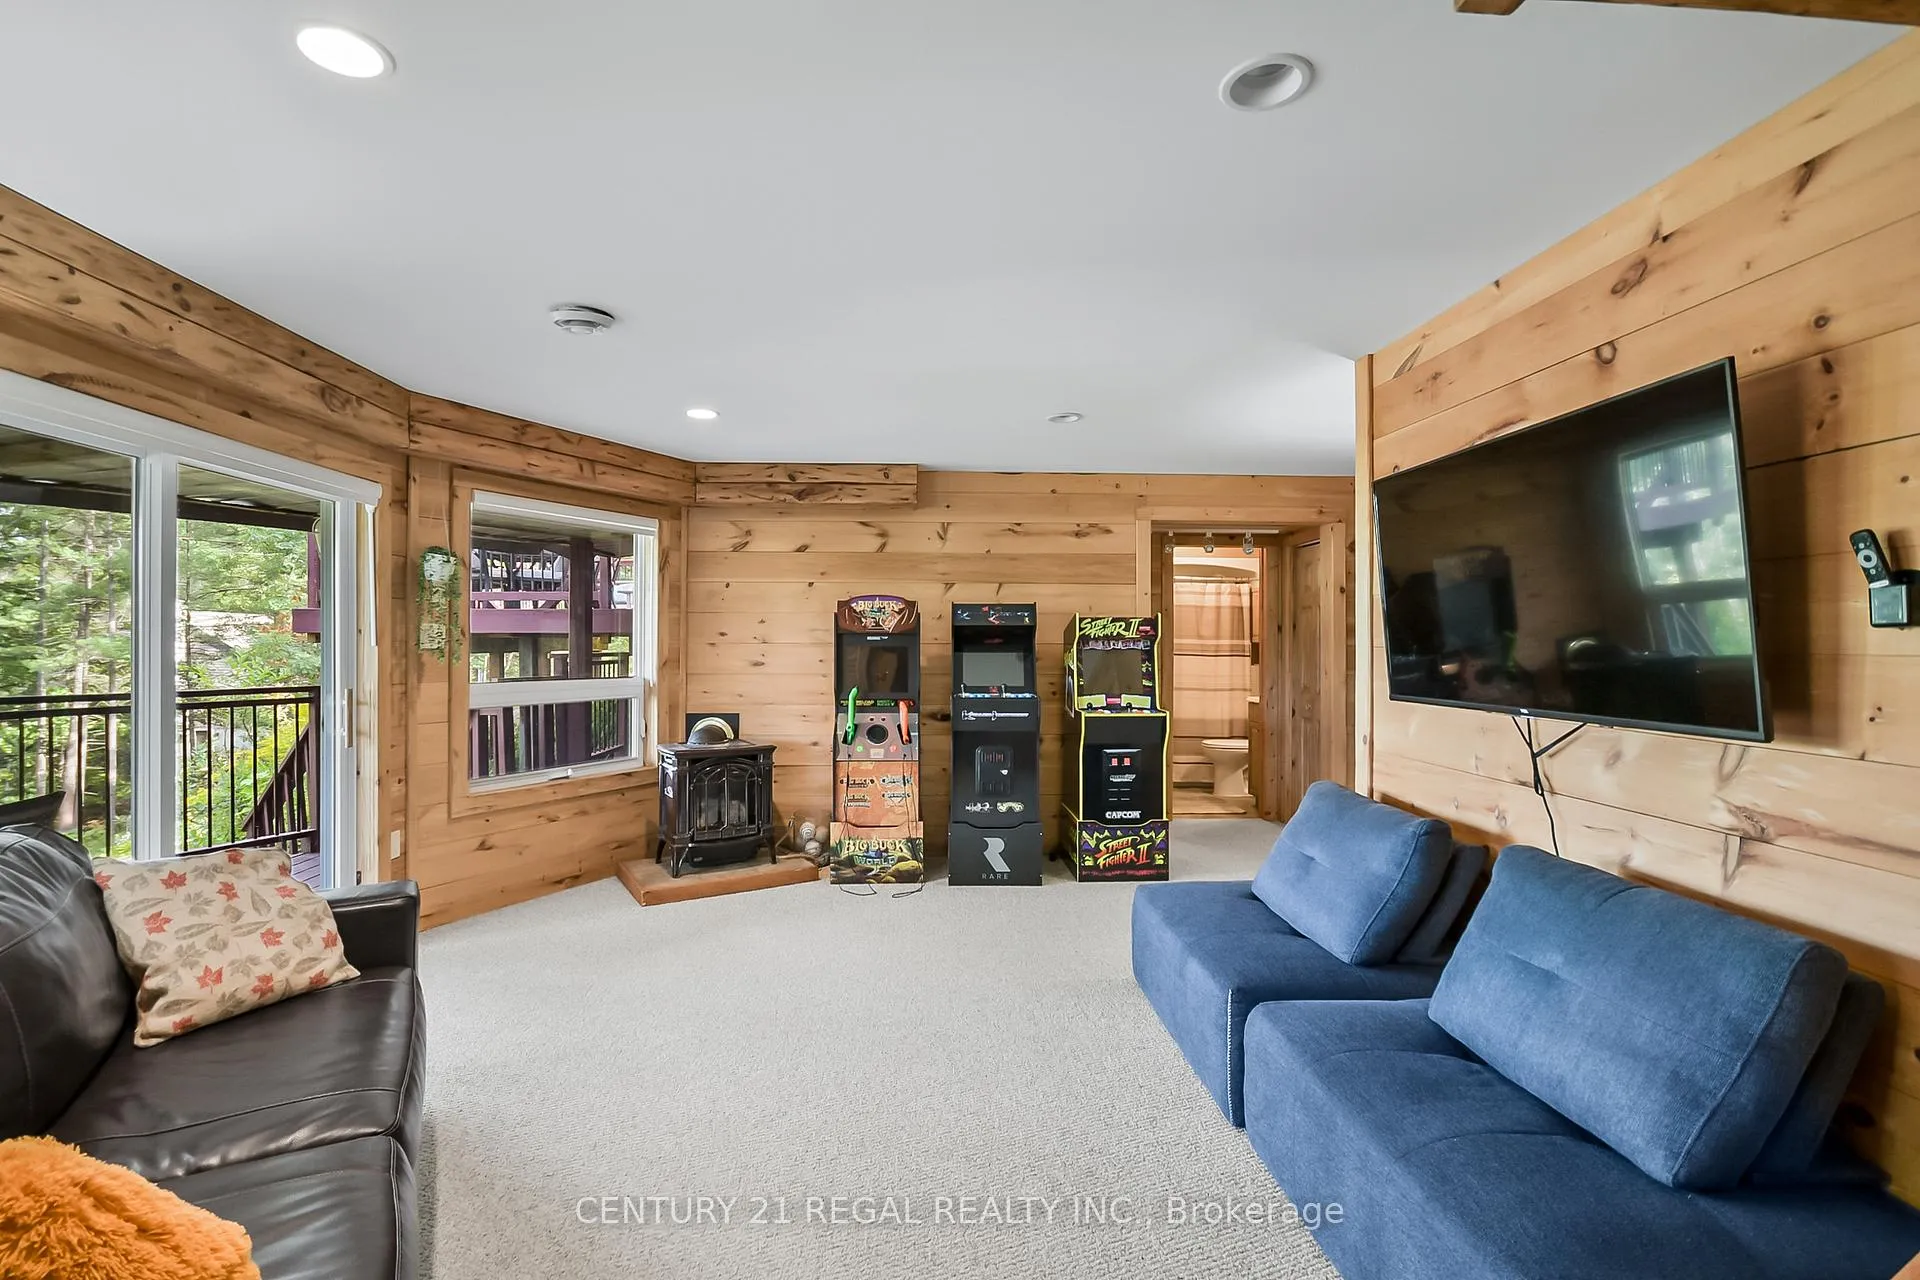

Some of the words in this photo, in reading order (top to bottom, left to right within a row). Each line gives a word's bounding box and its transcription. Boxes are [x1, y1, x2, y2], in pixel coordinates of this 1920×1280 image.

[1105, 810, 1142, 819] CAPCOM
[844, 839, 868, 853] BIG
[870, 839, 905, 853] BUCK
[1095, 836, 1140, 858] STREET
[1096, 847, 1138, 869] FIGHTER
[1136, 842, 1152, 866] II
